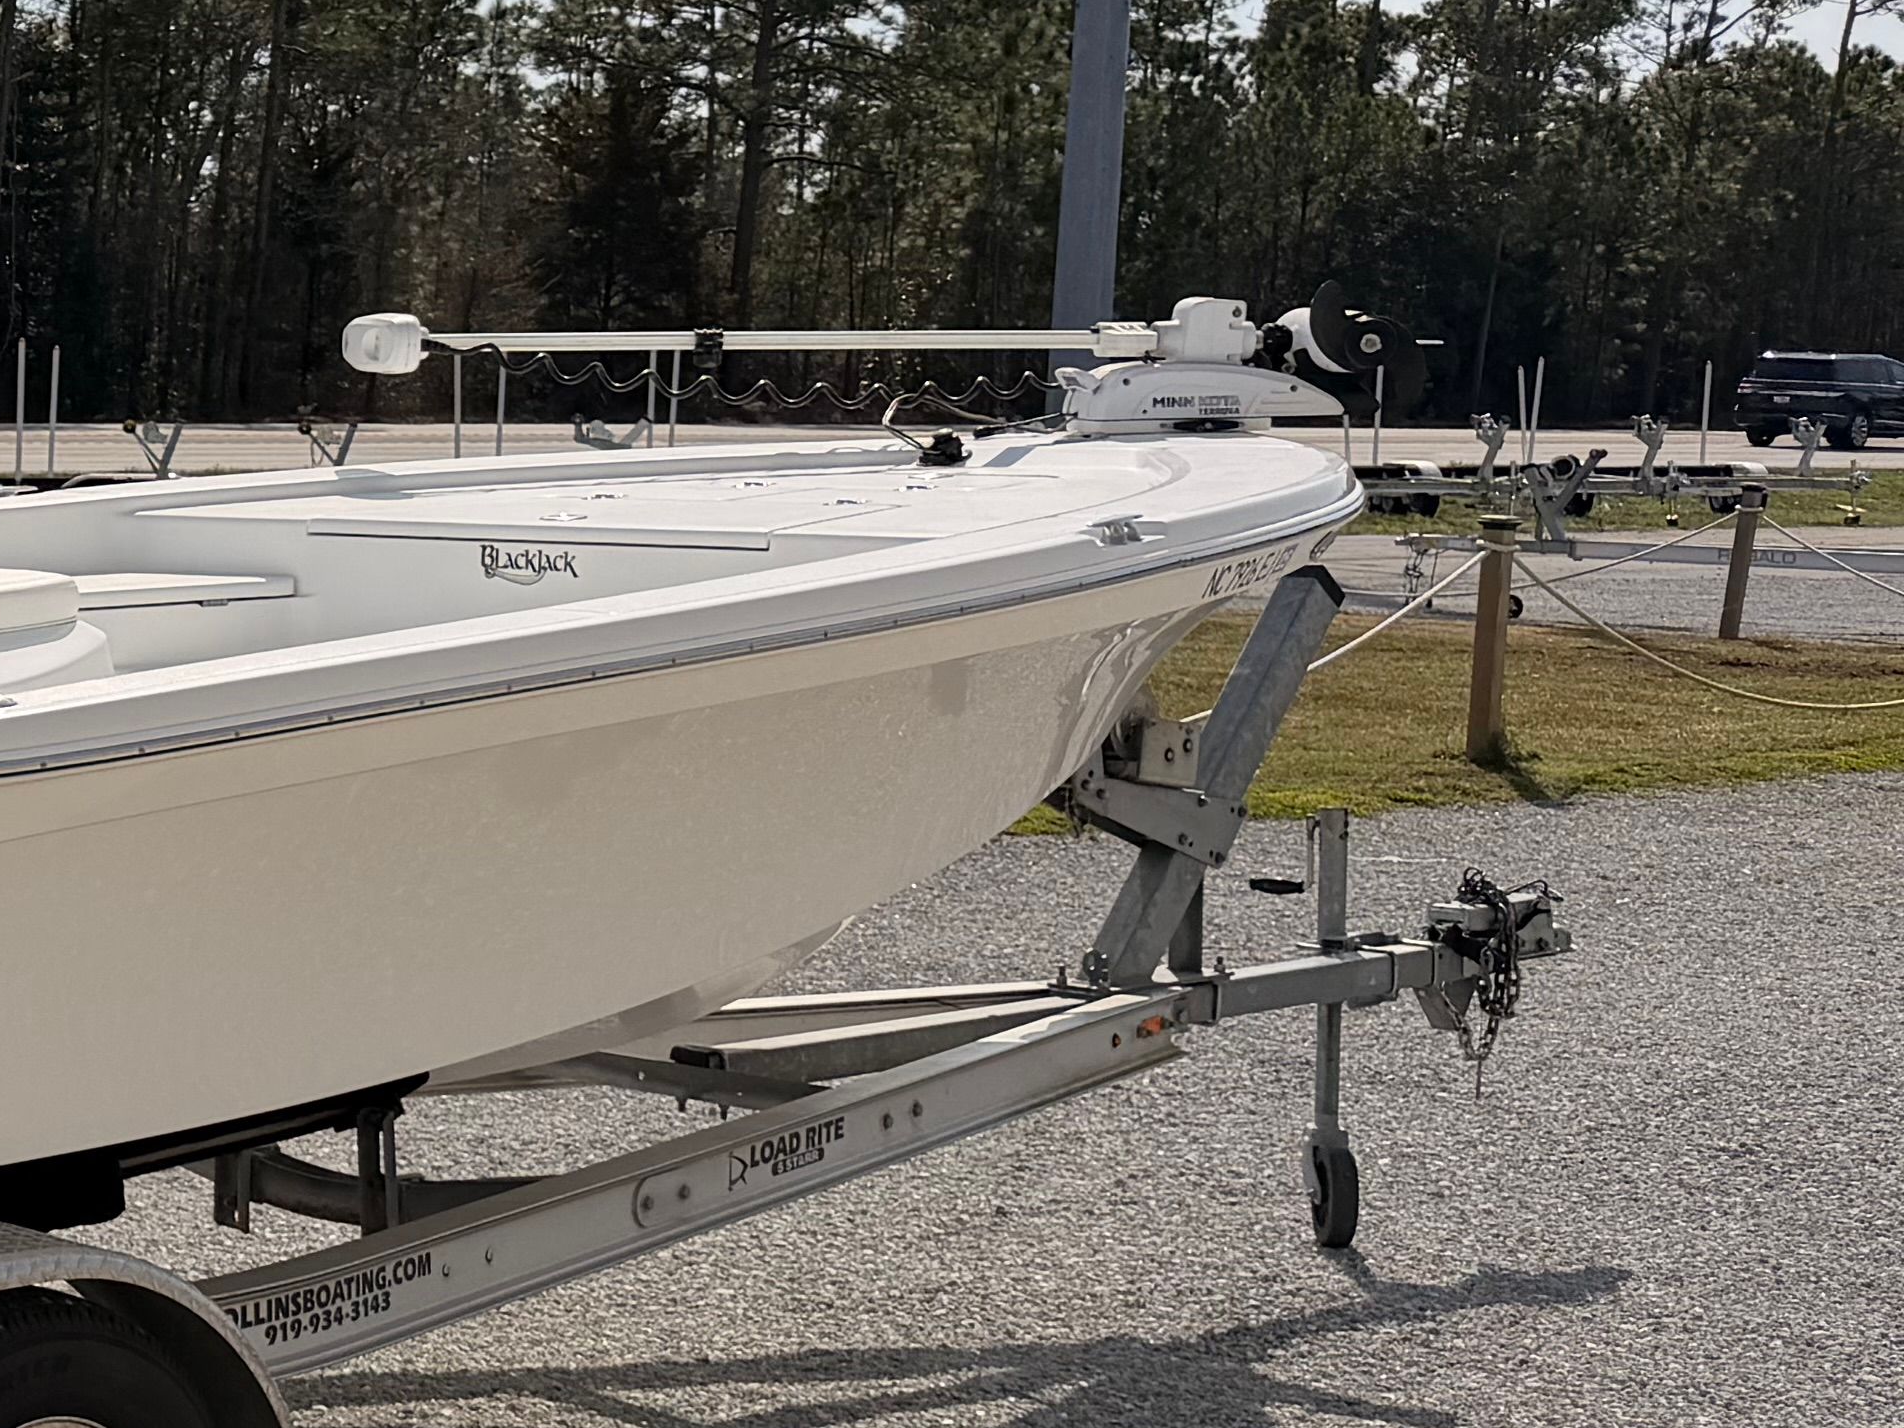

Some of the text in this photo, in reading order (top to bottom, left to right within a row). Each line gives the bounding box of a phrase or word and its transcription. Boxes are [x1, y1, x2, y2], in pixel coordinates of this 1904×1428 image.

[1152, 396, 1195, 409] MINN
[1718, 549, 1797, 565] RBALO
[1201, 565, 1233, 599] NC
[750, 1116, 845, 1168] LOAD RITE
[223, 1252, 432, 1329] OLLINSBOATING.COM
[264, 1291, 391, 1346] 919-934-3143
